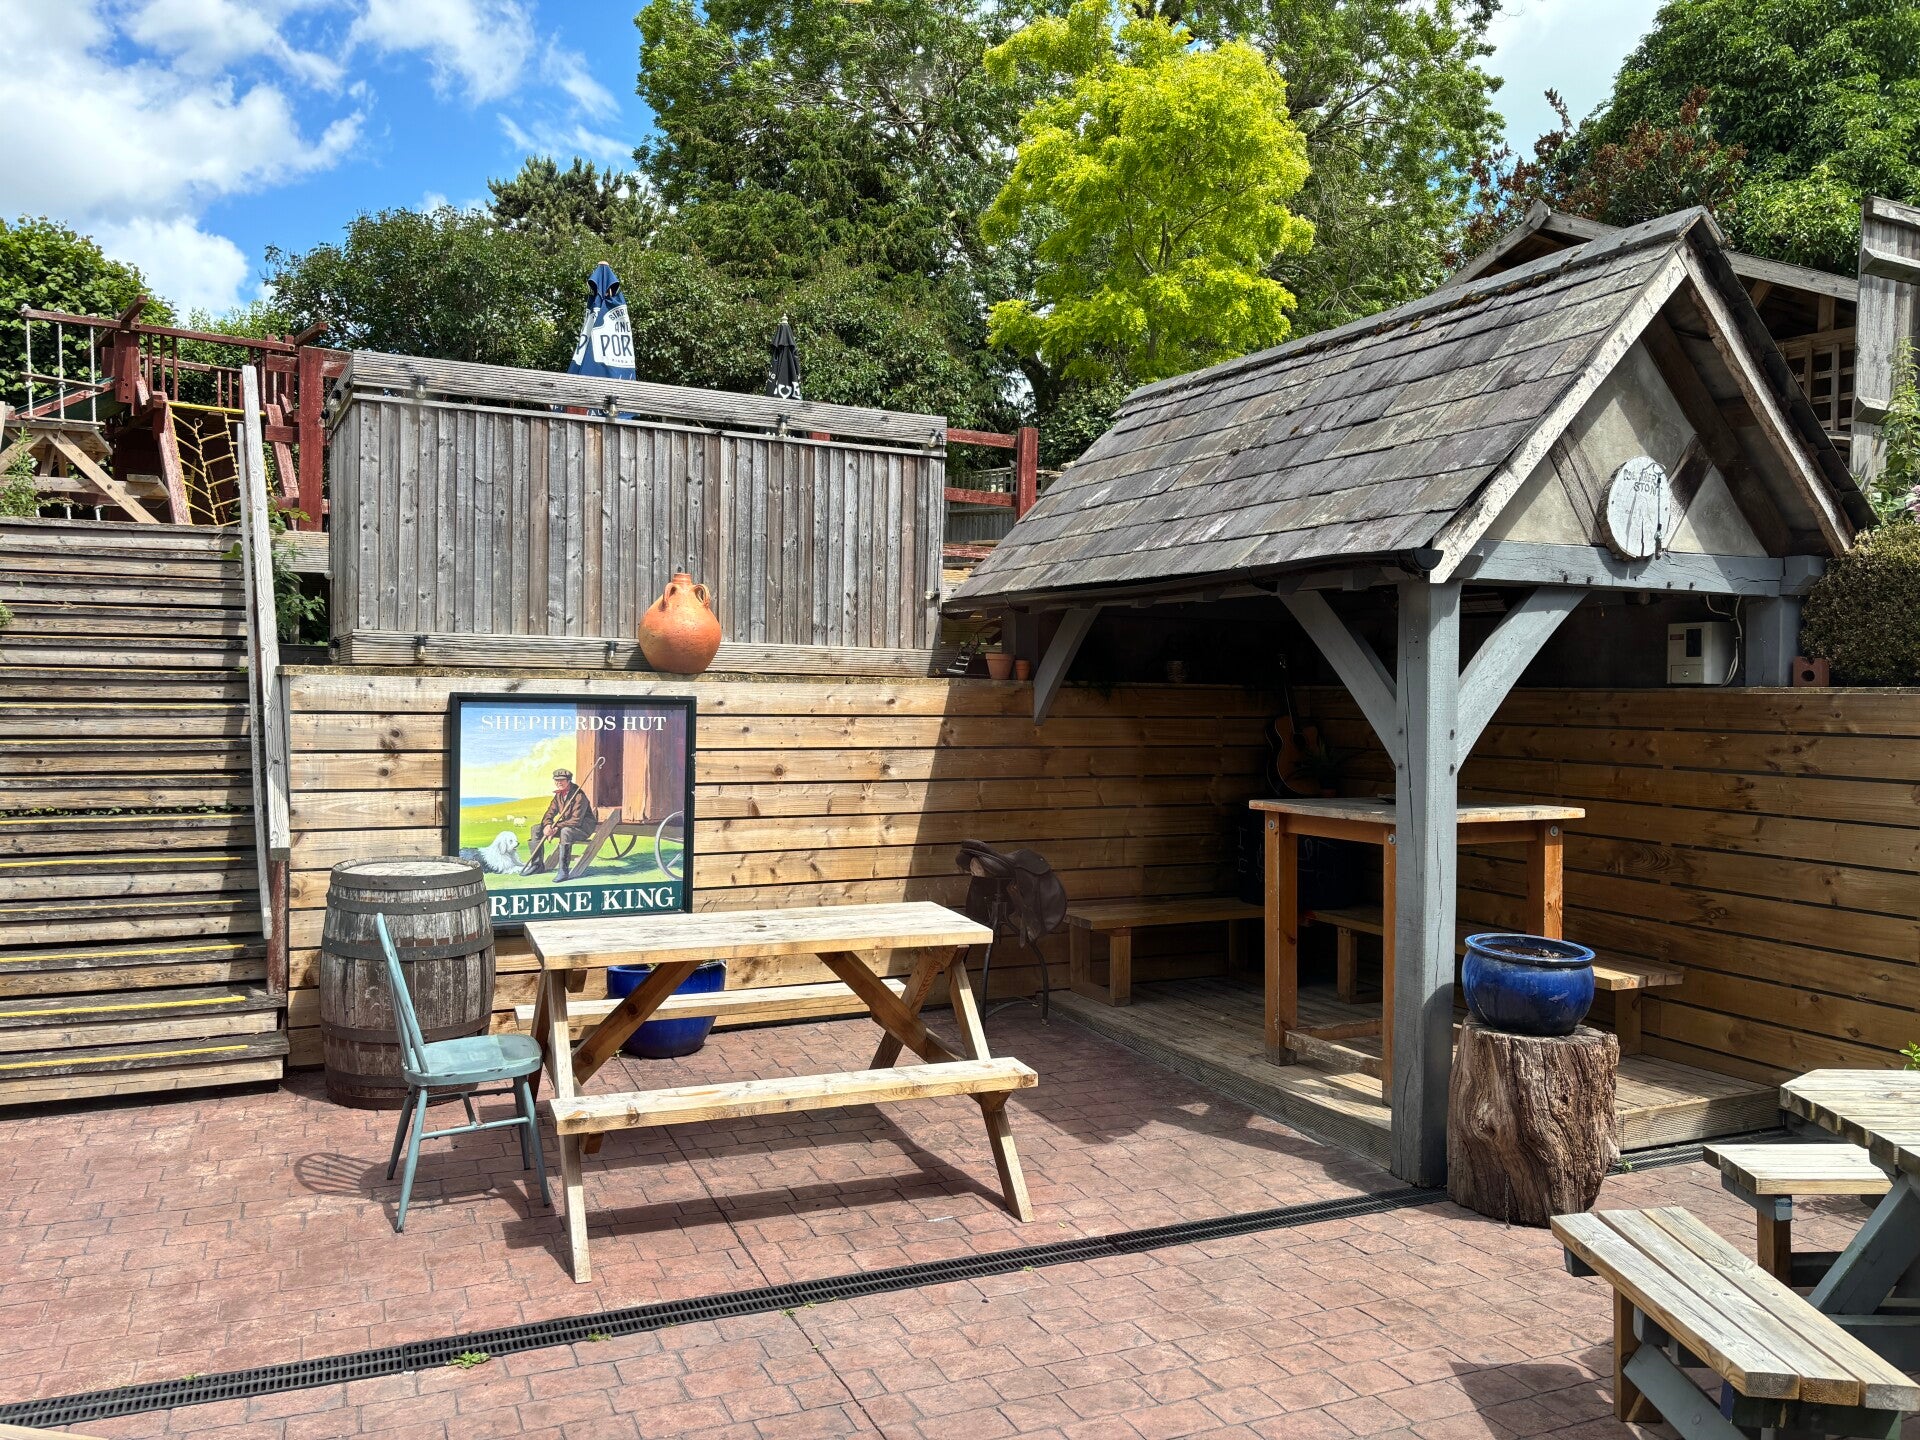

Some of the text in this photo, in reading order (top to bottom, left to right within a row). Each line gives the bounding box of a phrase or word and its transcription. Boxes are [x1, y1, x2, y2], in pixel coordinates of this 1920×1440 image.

[608, 308, 627, 321] BIRR
[1633, 481, 1660, 497] STON
[480, 715, 667, 731] SHEPHERDS HUT
[489, 886, 675, 917] REENE KING
